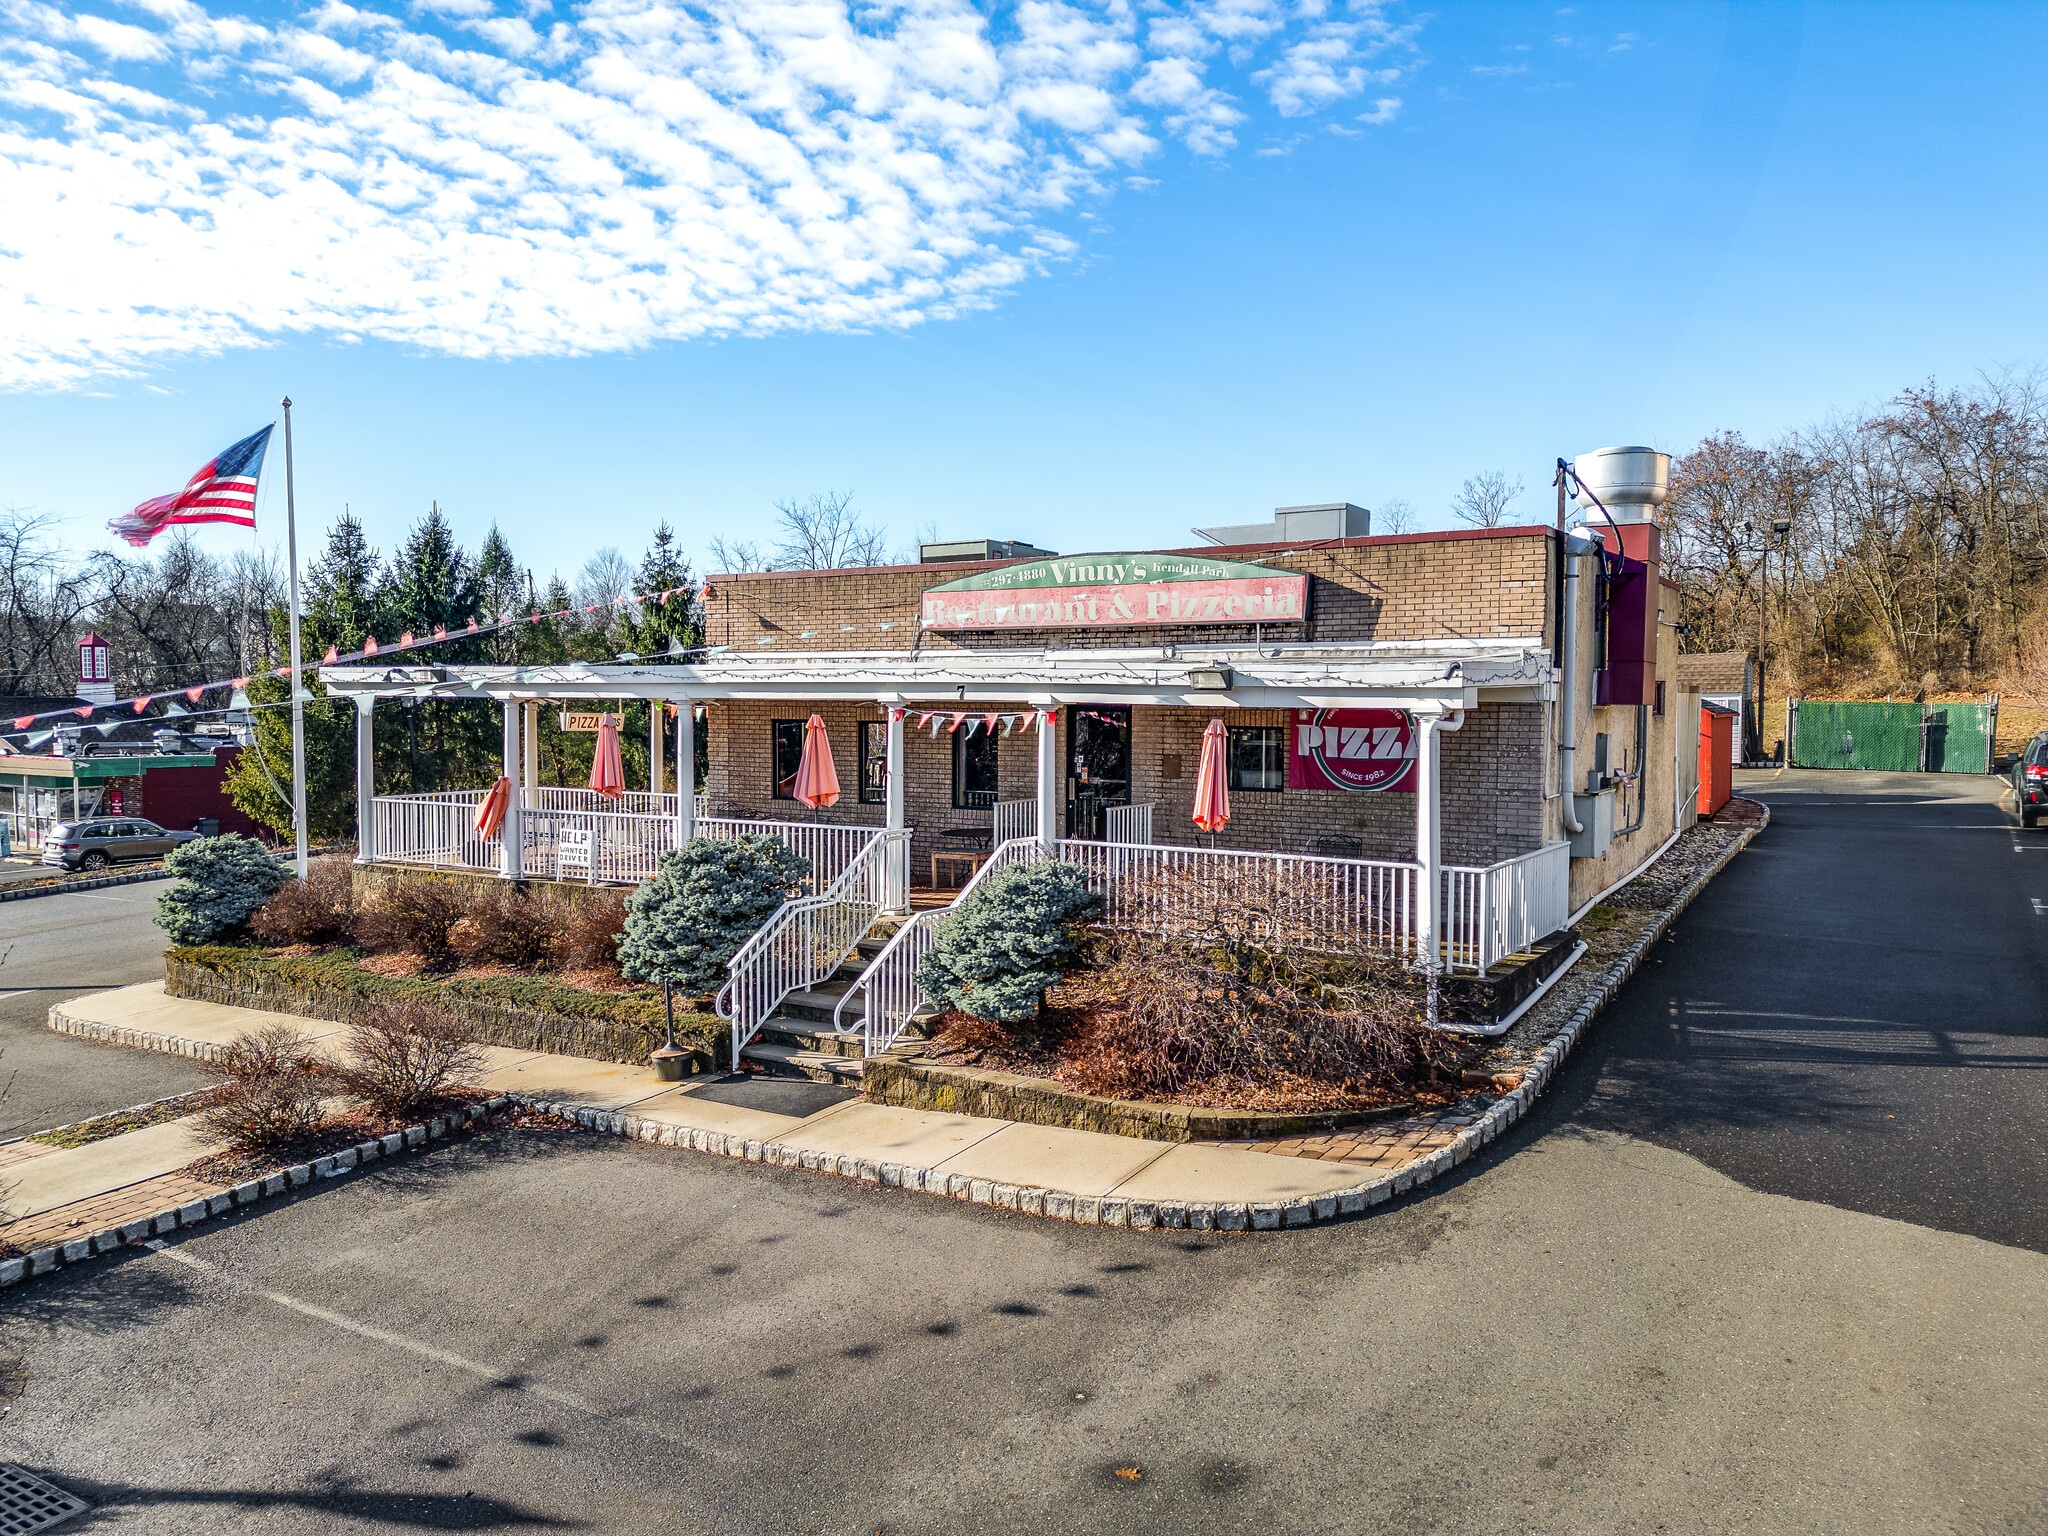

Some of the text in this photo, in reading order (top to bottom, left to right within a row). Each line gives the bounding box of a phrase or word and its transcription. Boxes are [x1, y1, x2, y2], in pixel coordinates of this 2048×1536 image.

[1050, 558, 1147, 585] Vinny's
[1152, 562, 1199, 575] Kendall
[1201, 566, 1230, 578] Park
[1108, 592, 1135, 619] &
[1147, 586, 1298, 620] Pizzeria
[956, 685, 965, 701] 7
[569, 716, 599, 729] PIZZA
[1341, 768, 1386, 782] SINCE 1982
[561, 830, 588, 845] HELP
[560, 846, 588, 855] WANTED
[559, 854, 588, 863] DRIVER
